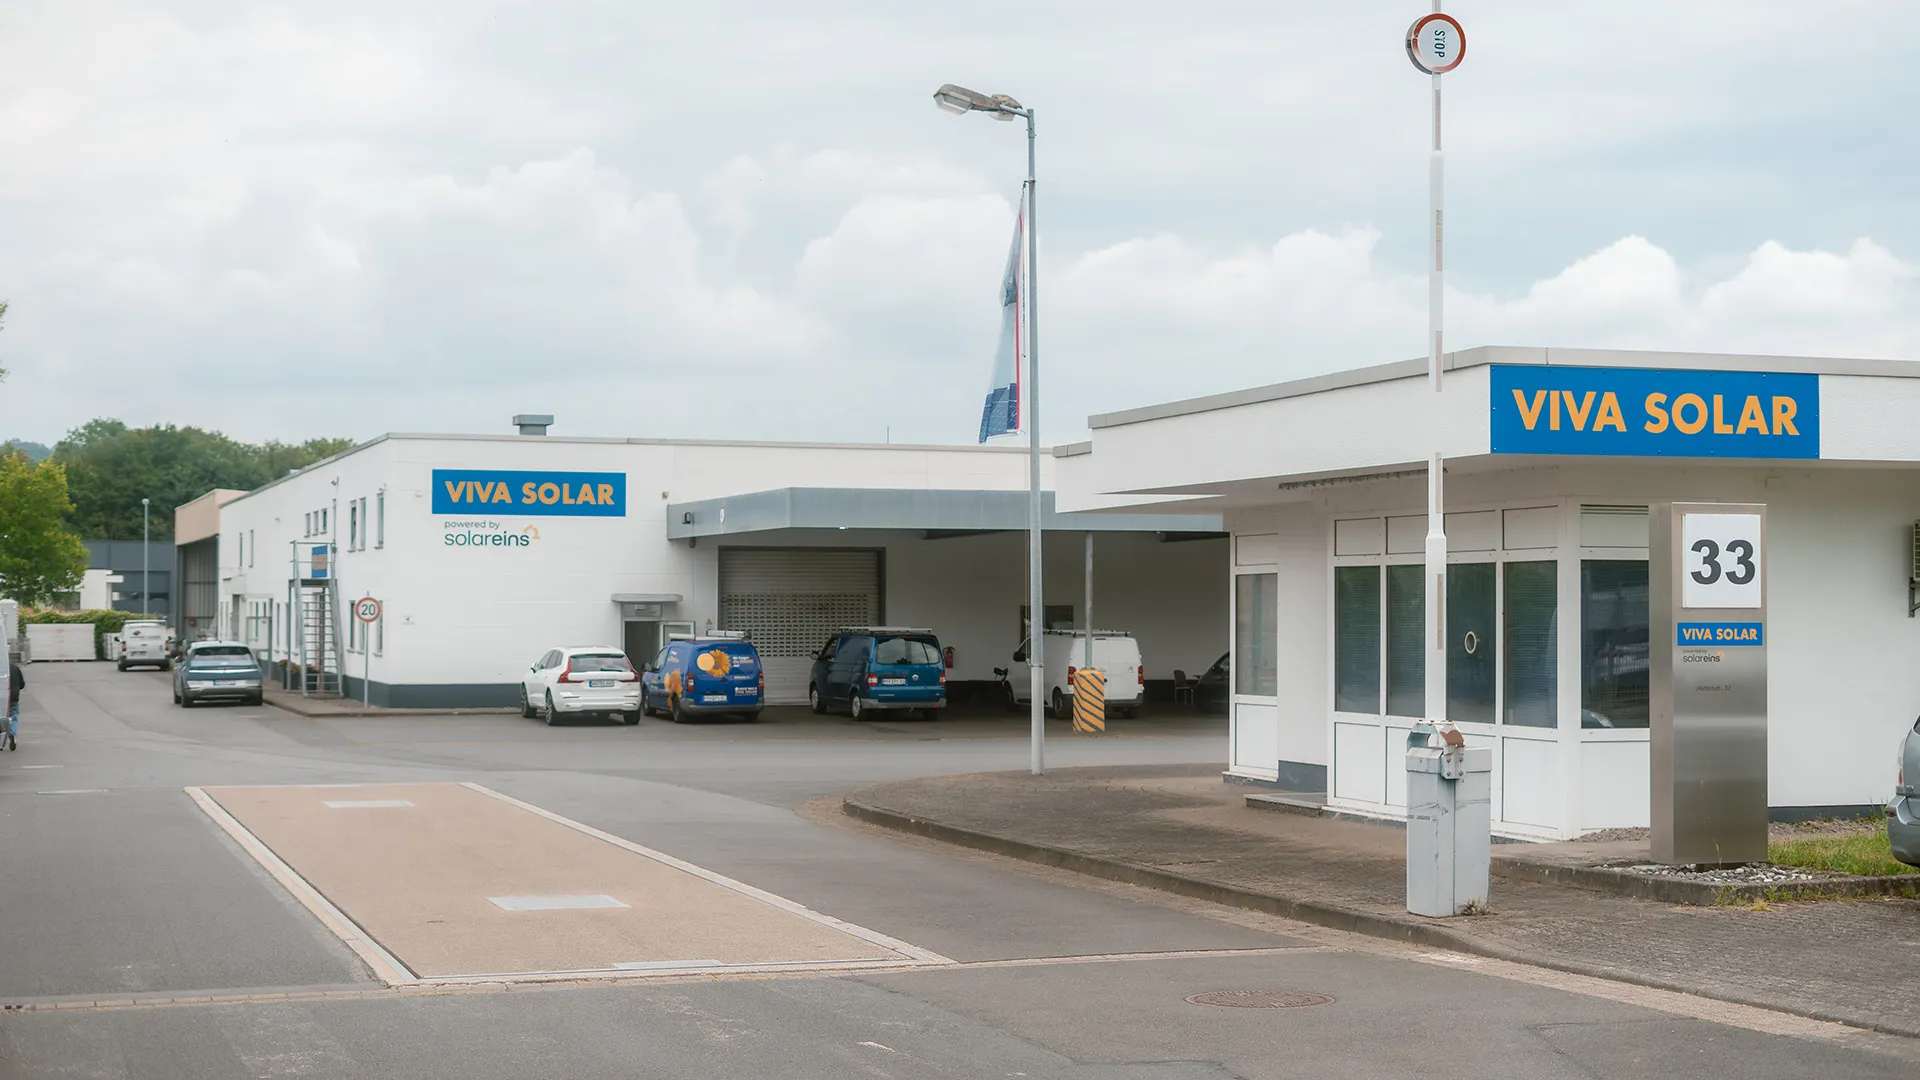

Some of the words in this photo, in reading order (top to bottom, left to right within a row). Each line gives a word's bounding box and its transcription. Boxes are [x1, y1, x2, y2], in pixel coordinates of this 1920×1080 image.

[1434, 30, 1446, 58] STOP
[1512, 389, 1627, 432] VIVA
[1644, 392, 1800, 436] SOLAR
[445, 481, 512, 503] VIVA
[521, 482, 615, 505] SOLAR
[444, 520, 486, 529] powered
[489, 520, 500, 530] by
[444, 530, 530, 546] solareins
[1690, 539, 1756, 585] 33
[361, 603, 376, 616] 20
[1682, 628, 1712, 640] VIVA
[1716, 628, 1757, 640] SOLAR
[1683, 654, 1720, 662] solareins
